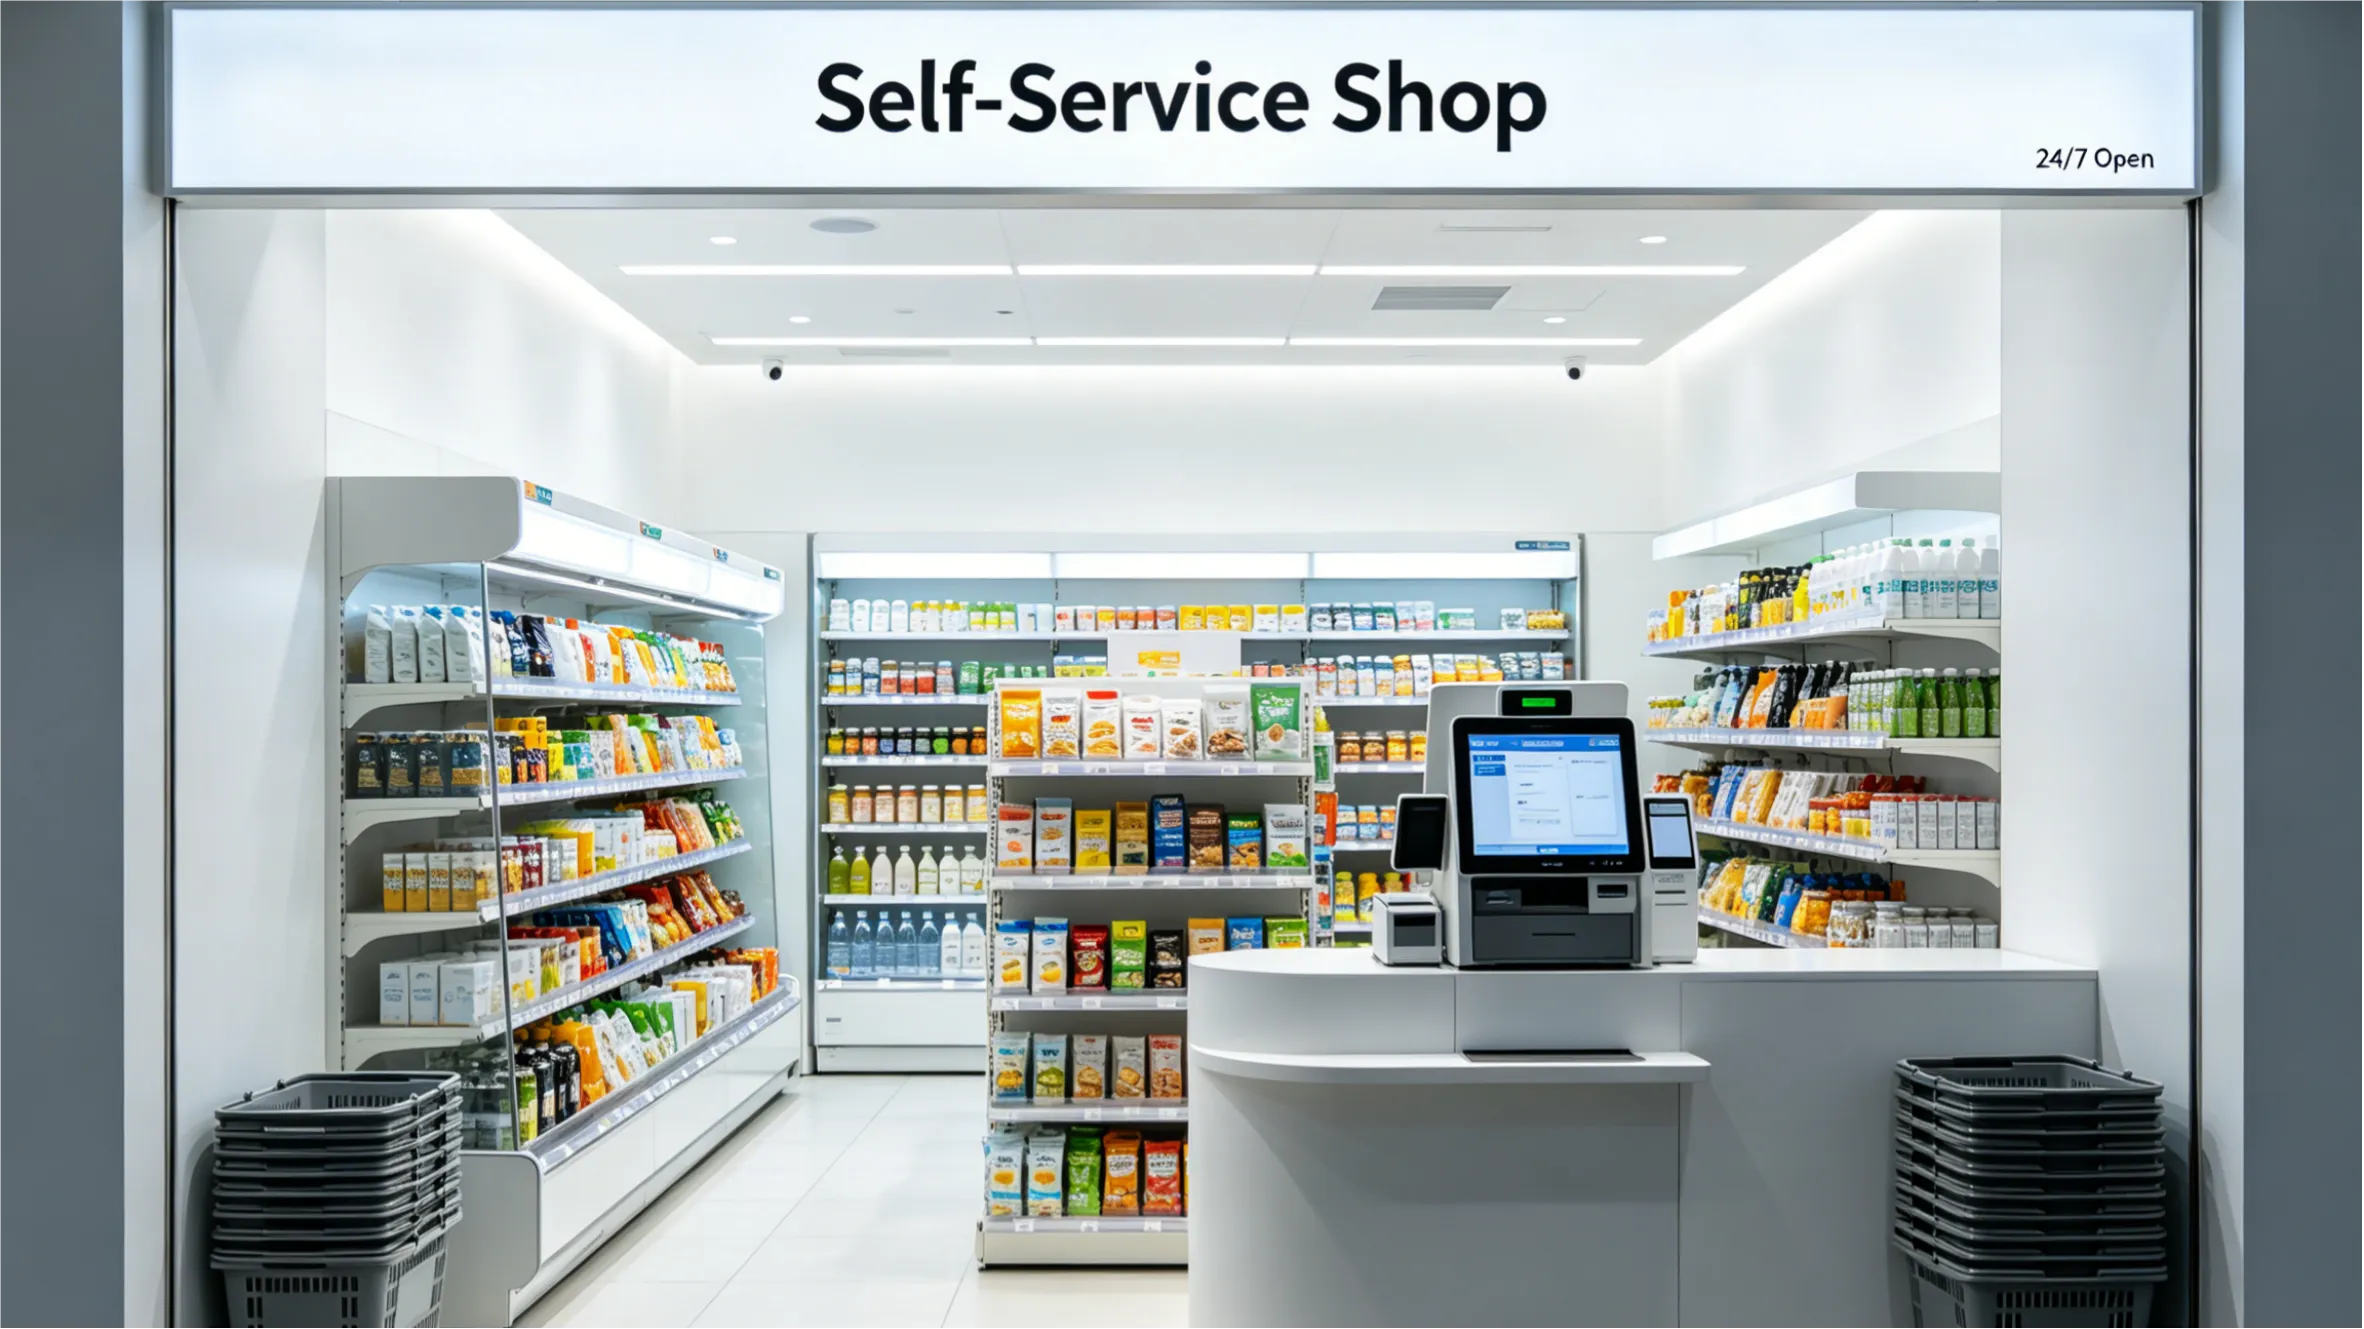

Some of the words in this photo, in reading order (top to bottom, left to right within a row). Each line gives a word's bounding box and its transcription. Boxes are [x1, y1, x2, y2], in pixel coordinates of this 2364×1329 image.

[815, 58, 1310, 133] Self-Service
[1332, 59, 1547, 153] Shop
[2035, 146, 2088, 171] 24/7
[2095, 147, 2155, 174] Open
